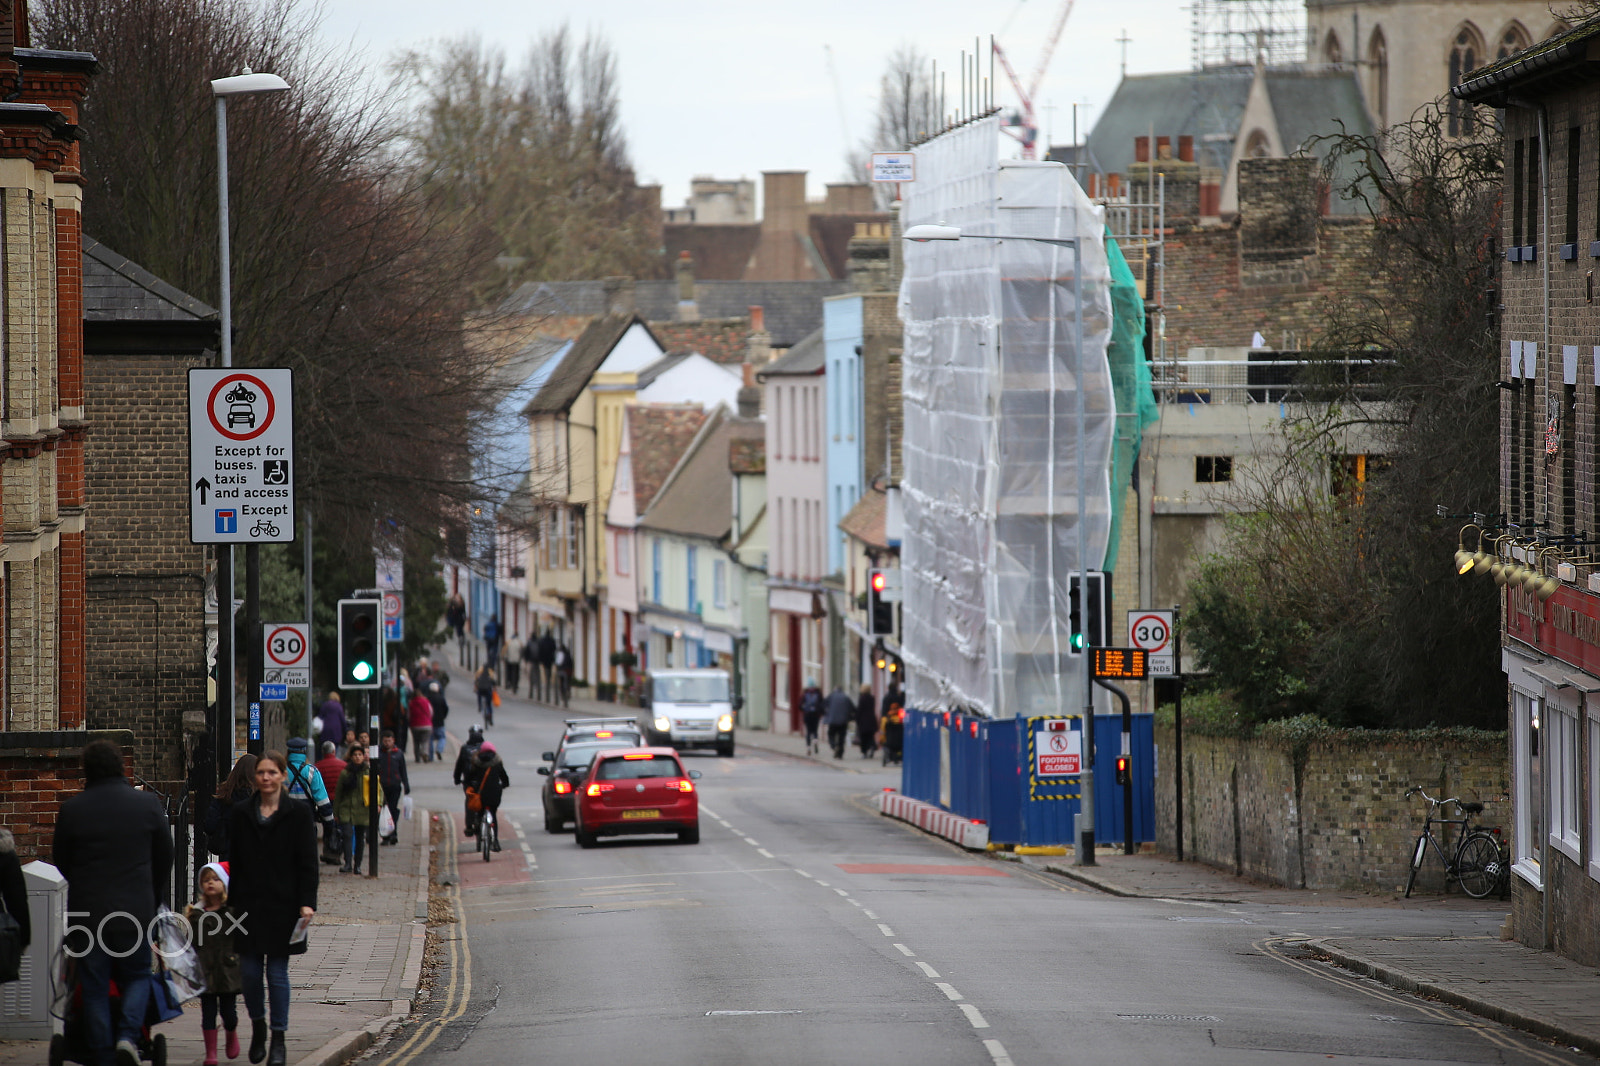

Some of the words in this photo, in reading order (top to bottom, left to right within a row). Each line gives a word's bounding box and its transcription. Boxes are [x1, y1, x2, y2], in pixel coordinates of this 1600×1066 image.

[215, 445, 261, 458] Except
[265, 445, 285, 456] for
[214, 473, 247, 485] taxis
[215, 487, 239, 498] and
[244, 489, 289, 498] access
[242, 504, 288, 517] Except
[1138, 626, 1165, 642] 30
[273, 638, 301, 654] 30
[283, 677, 307, 685] ENDS
[1041, 756, 1078, 764] FOOTPATH
